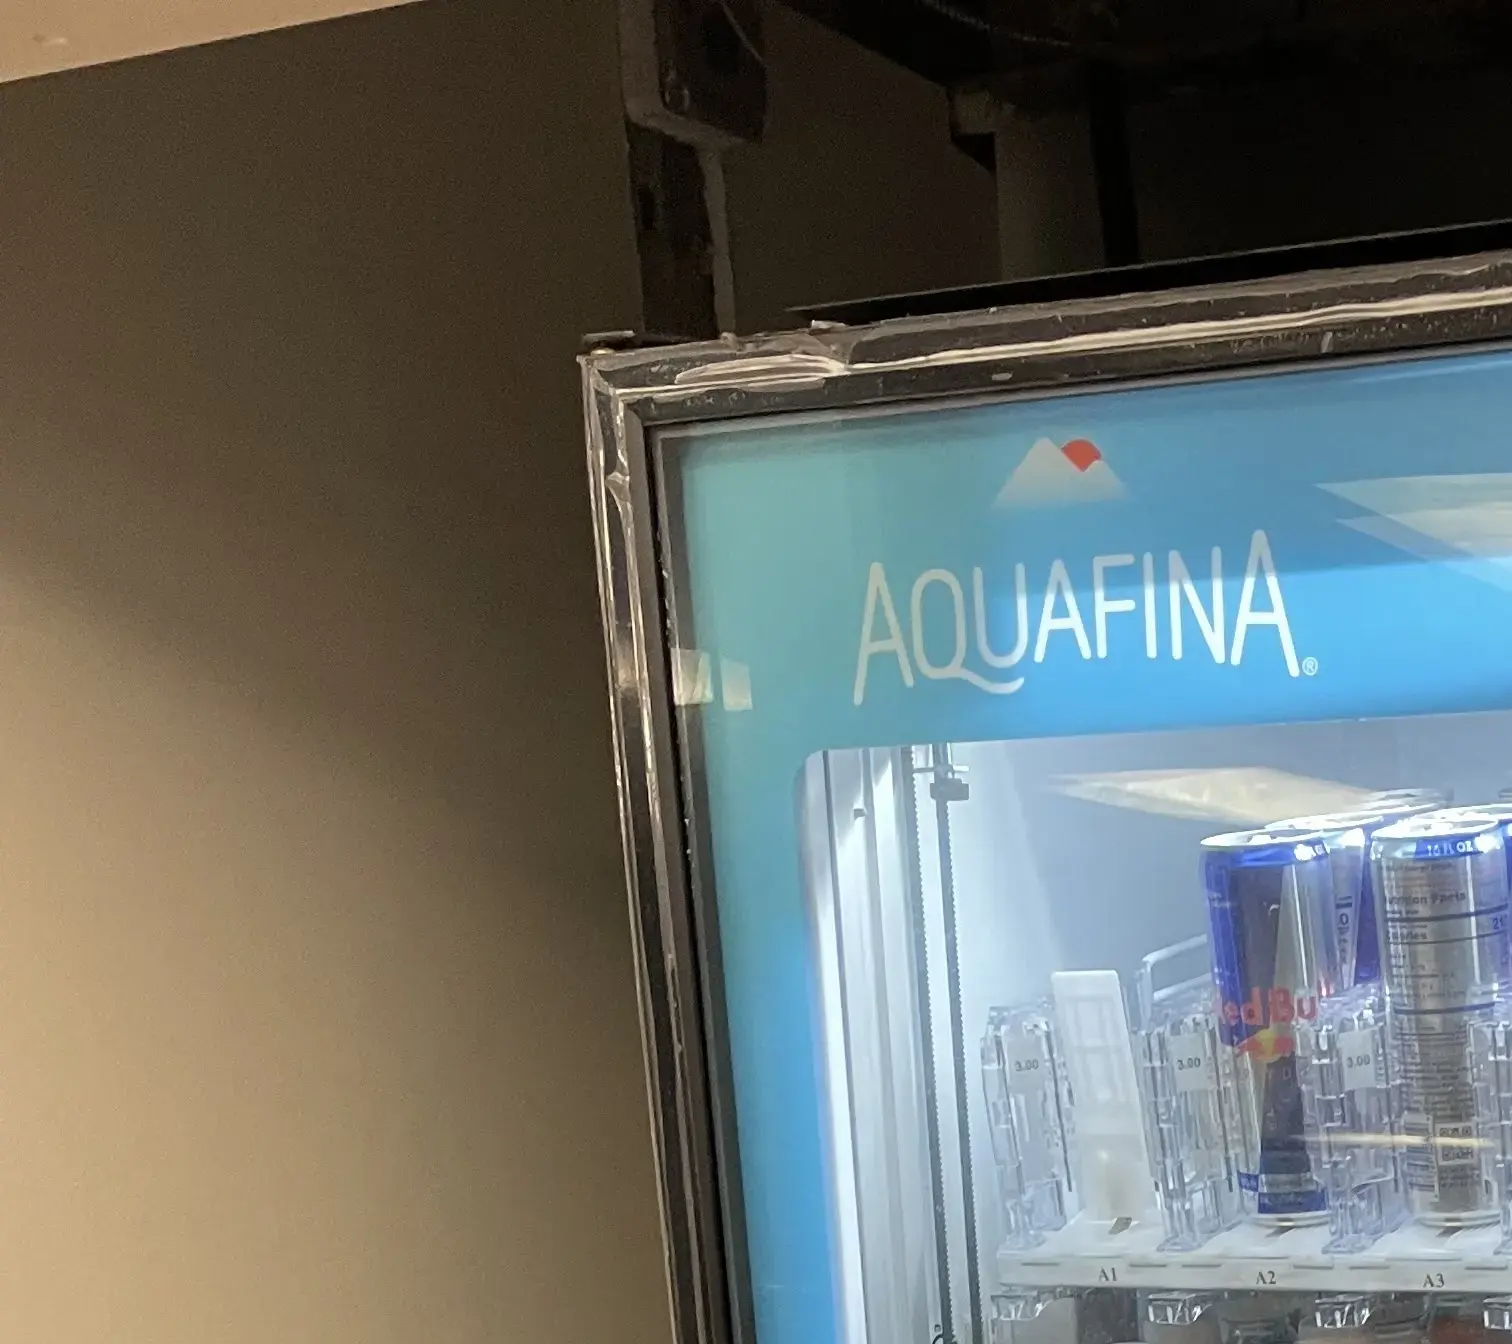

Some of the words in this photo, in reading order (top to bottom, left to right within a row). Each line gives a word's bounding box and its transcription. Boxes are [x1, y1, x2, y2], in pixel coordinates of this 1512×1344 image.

[853, 529, 1299, 706] AQUAFINA
[1177, 1055, 1201, 1072] 3.00
[1347, 1054, 1371, 1068] 3.00
[1098, 1267, 1118, 1284] A1
[1255, 1269, 1278, 1287] A2
[1422, 1273, 1445, 1289] A3
